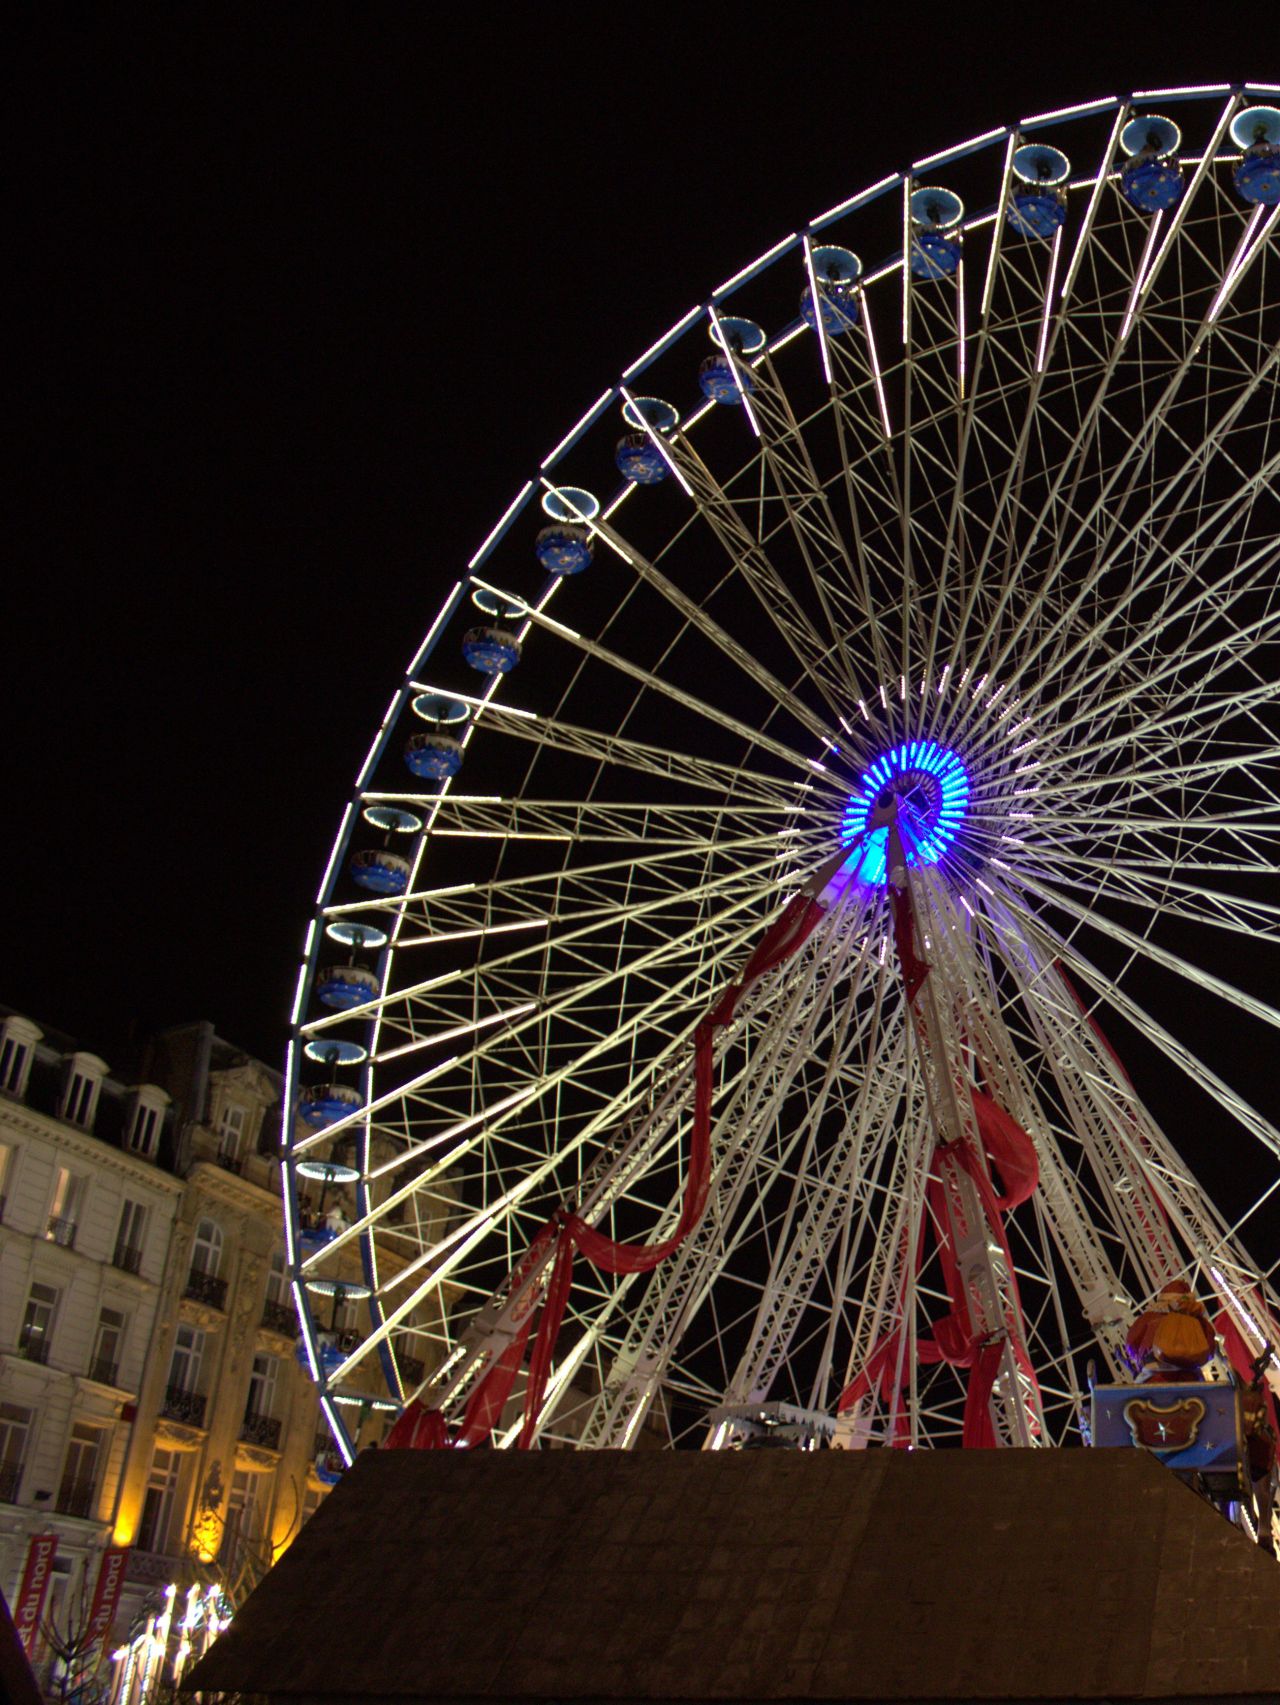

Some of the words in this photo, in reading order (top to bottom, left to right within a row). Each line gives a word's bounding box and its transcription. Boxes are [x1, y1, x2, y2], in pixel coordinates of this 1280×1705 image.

[22, 1593, 40, 1619] du
[31, 1541, 52, 1589] nord
[102, 1554, 124, 1600] nord
